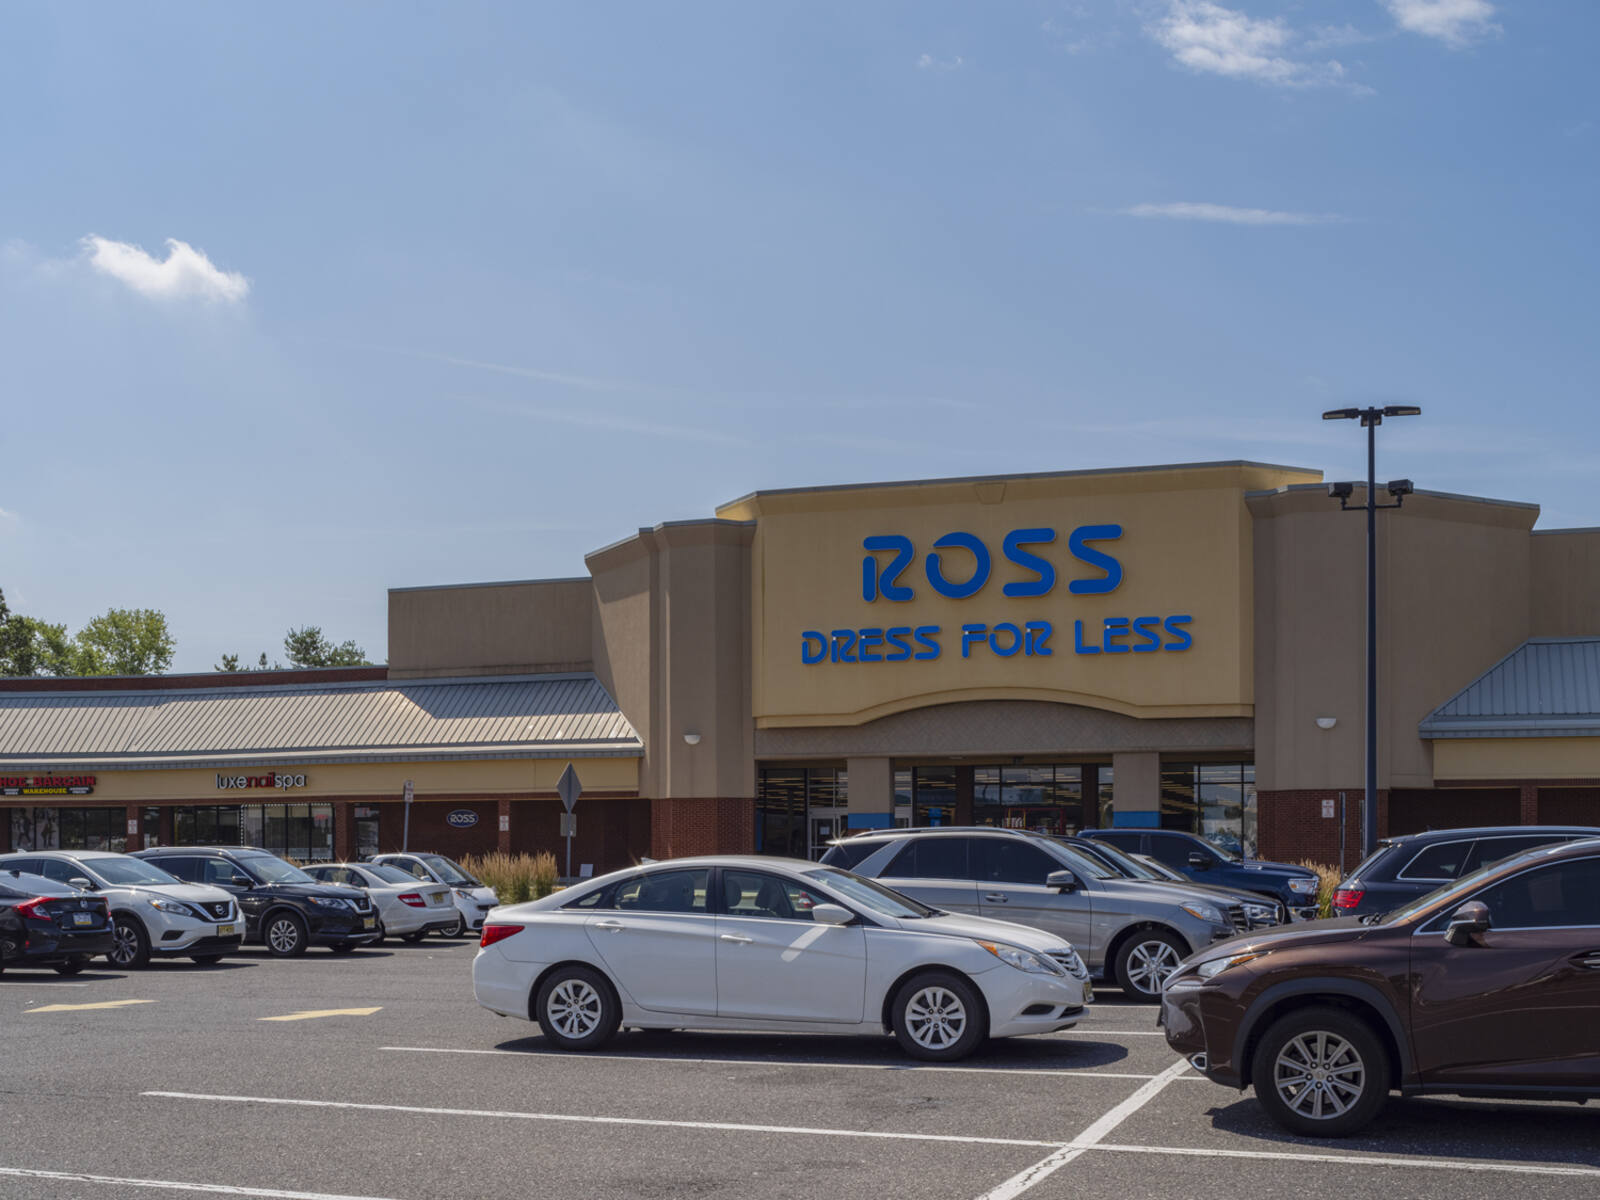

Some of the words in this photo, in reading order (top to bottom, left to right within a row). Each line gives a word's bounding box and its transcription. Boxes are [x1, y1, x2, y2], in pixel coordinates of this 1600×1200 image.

[863, 524, 1123, 602] ROSS
[801, 626, 941, 665] DRESS
[961, 621, 1053, 659] FOR
[1074, 615, 1193, 655] LESS
[33, 775, 96, 786] BARGAIN
[450, 814, 476, 823] ROSS
